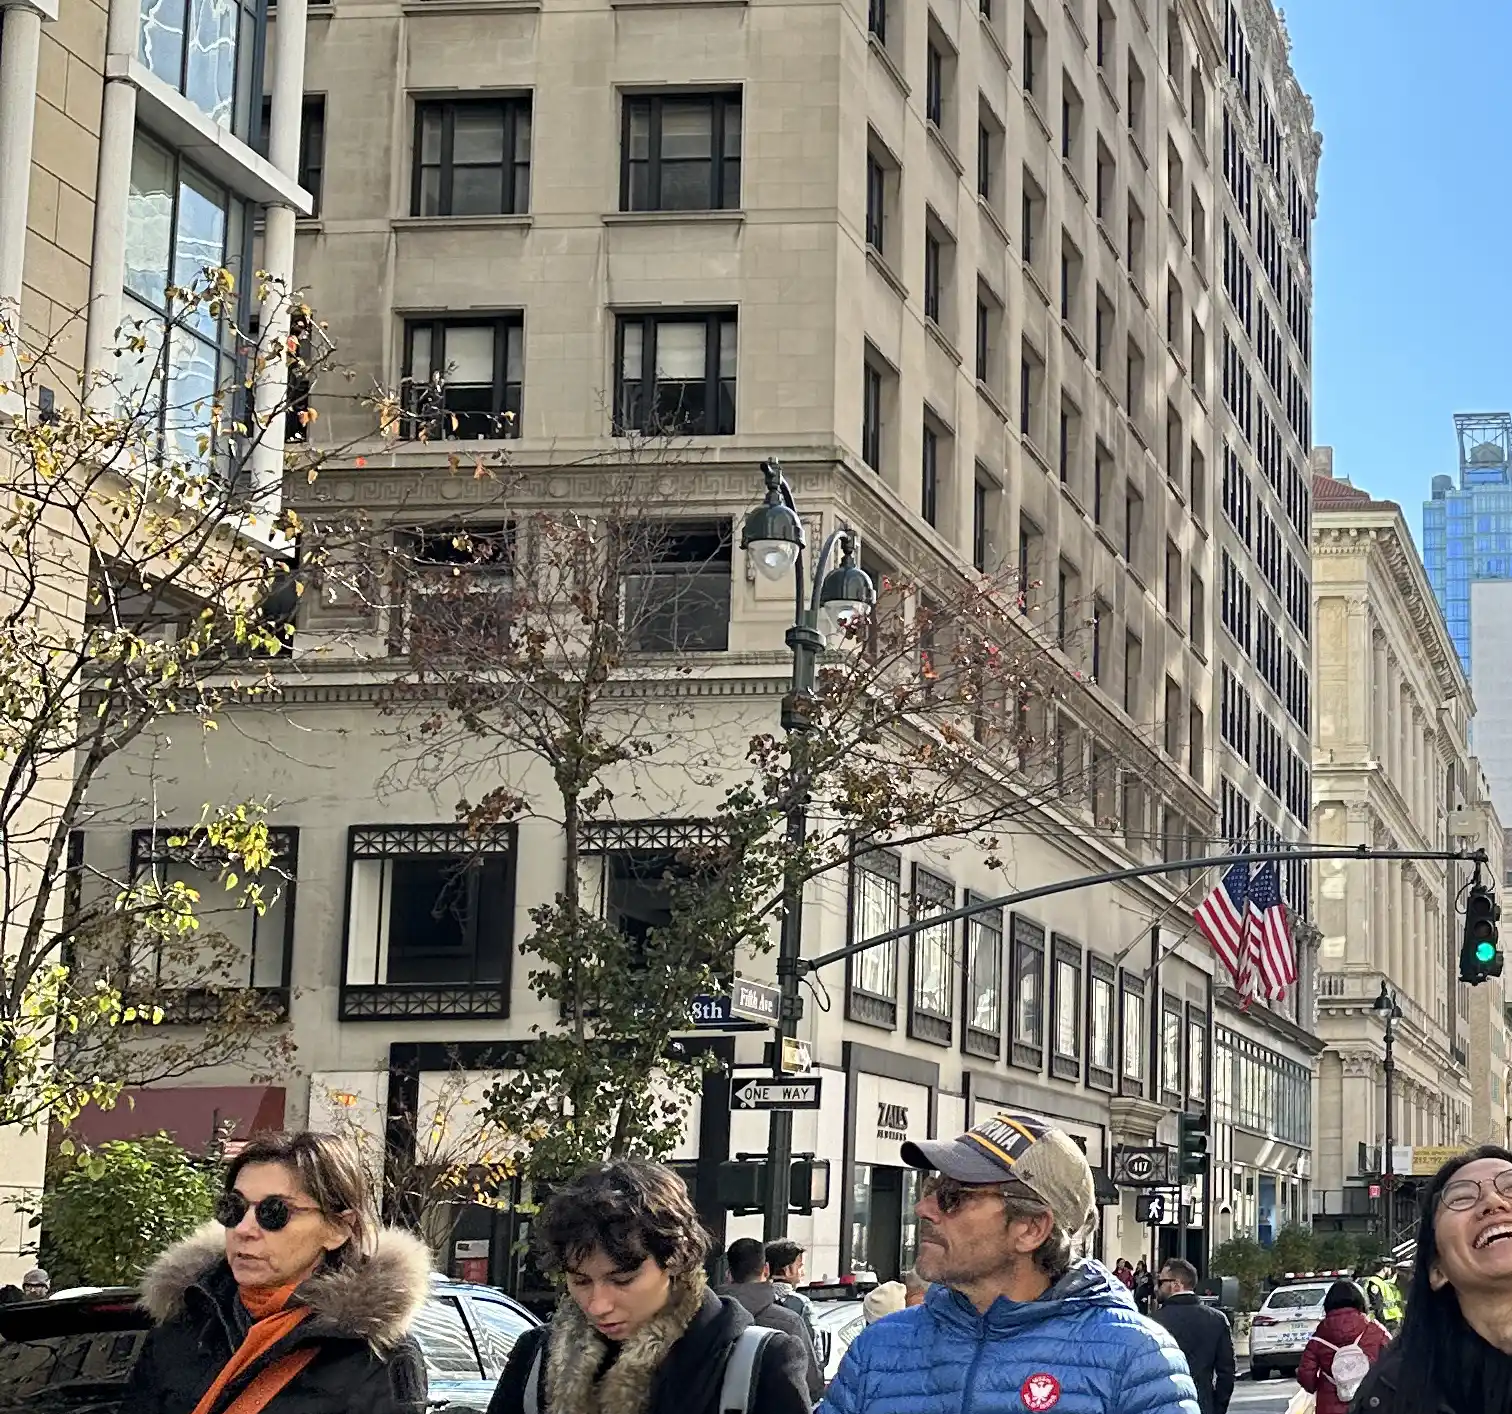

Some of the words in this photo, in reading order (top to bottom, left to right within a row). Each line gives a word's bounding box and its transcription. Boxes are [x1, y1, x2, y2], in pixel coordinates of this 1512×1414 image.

[691, 1001, 722, 1019] 8th
[744, 1087, 770, 1101] ONE
[782, 1087, 809, 1101] WAY
